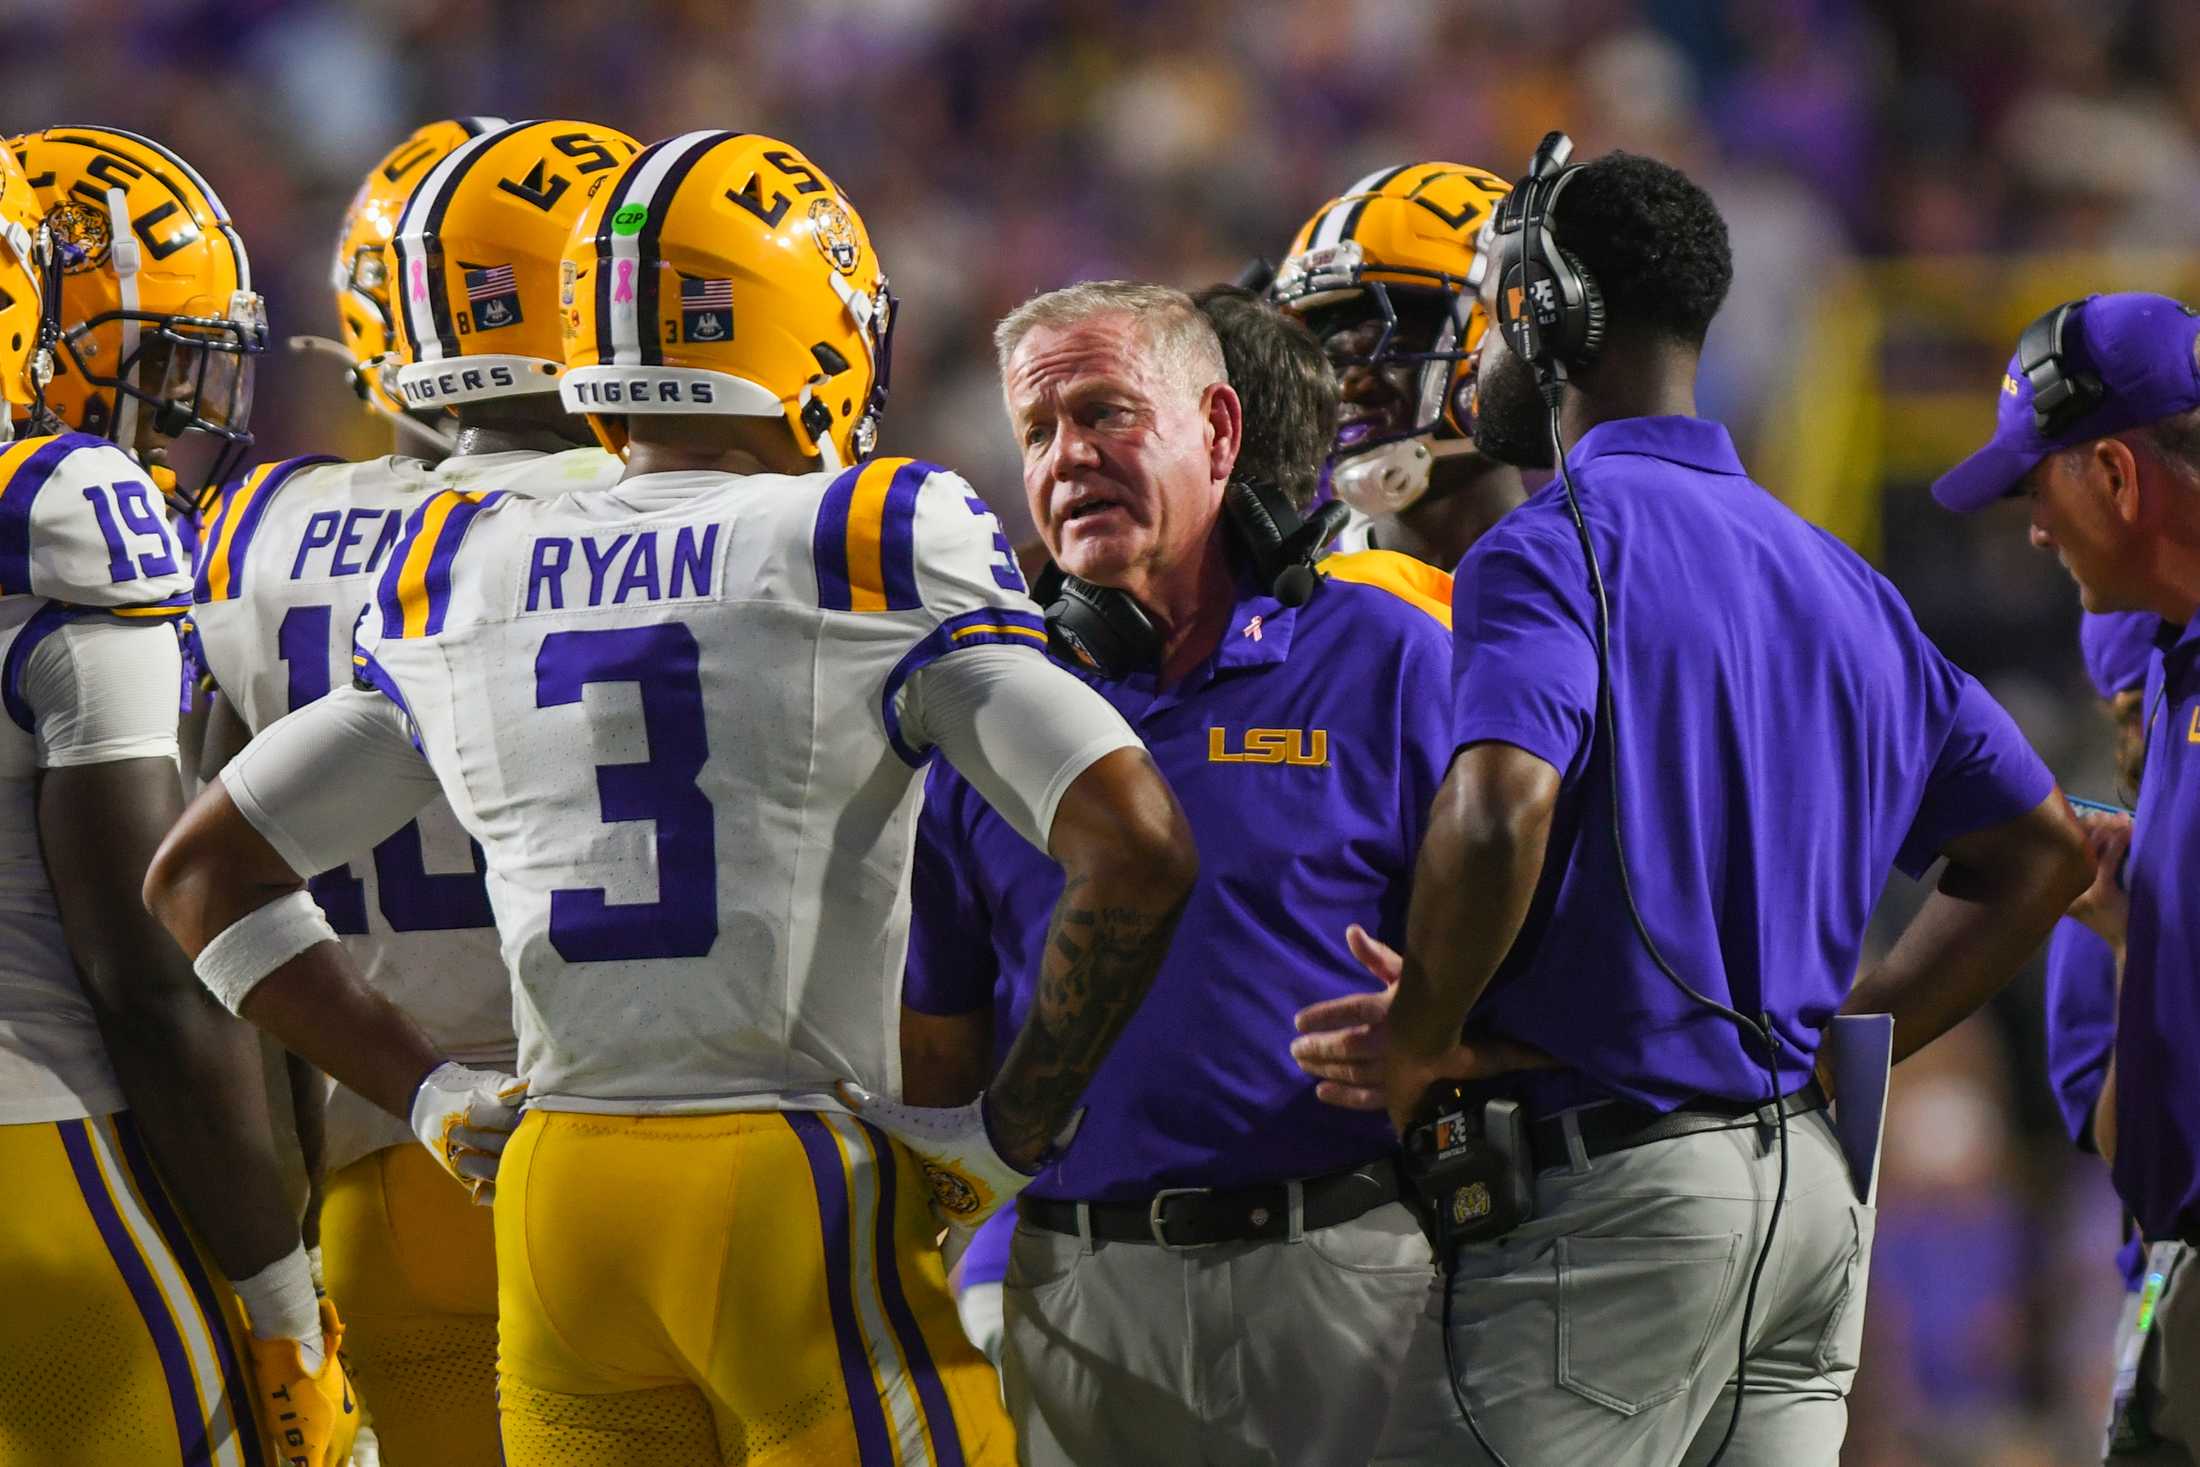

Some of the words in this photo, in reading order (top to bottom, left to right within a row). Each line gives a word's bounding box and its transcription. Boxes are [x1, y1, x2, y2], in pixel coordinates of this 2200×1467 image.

[614, 211, 645, 225] C2P
[664, 319, 679, 344] 3
[401, 366, 514, 403] TIGERS
[573, 380, 714, 404] TIGERS
[83, 480, 179, 583] 19
[525, 523, 720, 612] RYAN
[1208, 726, 1328, 766] LSU
[534, 621, 719, 964] 3
